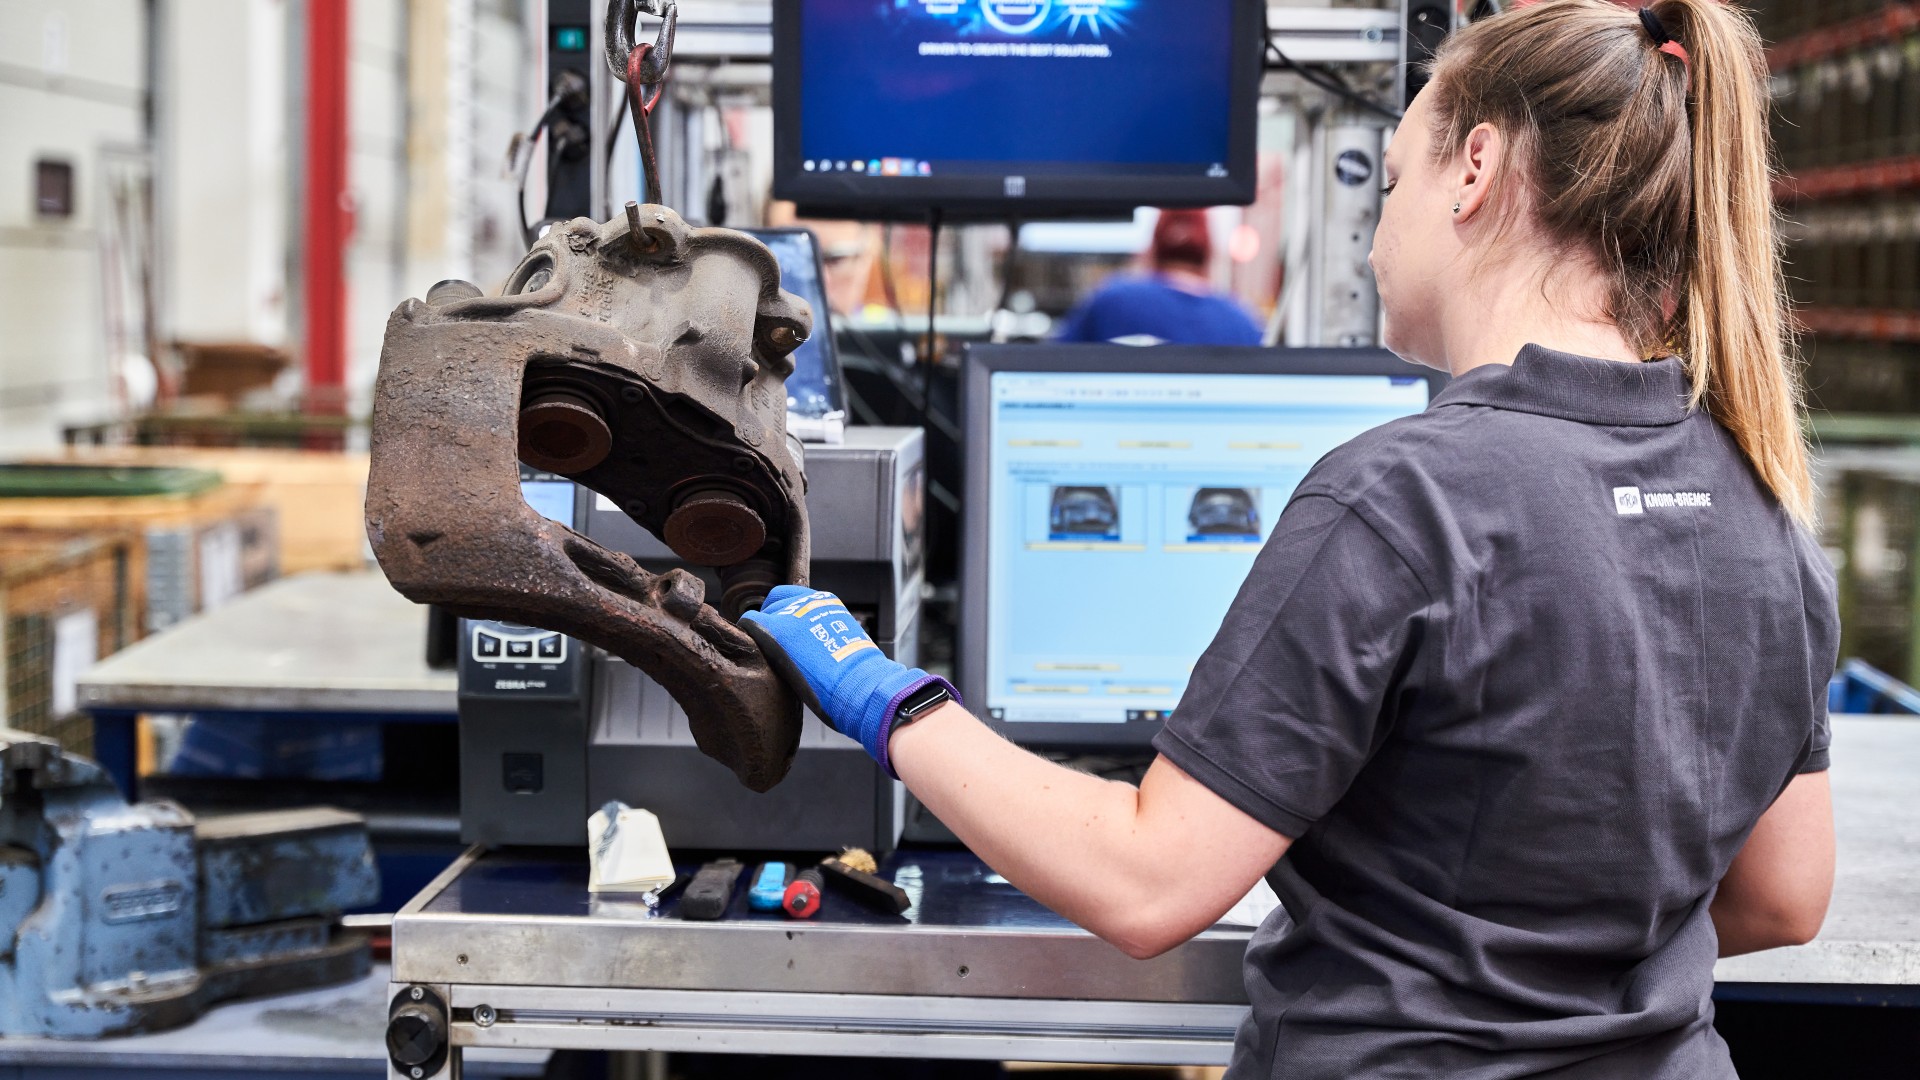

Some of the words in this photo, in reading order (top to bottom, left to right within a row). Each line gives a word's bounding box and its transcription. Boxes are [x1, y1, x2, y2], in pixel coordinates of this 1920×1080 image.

[918, 42, 956, 56] DRIVEN
[957, 42, 972, 56] TO
[972, 42, 1008, 56] CREATE
[1009, 43, 1027, 56] THE
[1644, 492, 1711, 508] KNORR-BREMSE
[495, 680, 526, 689] ZEBRA
